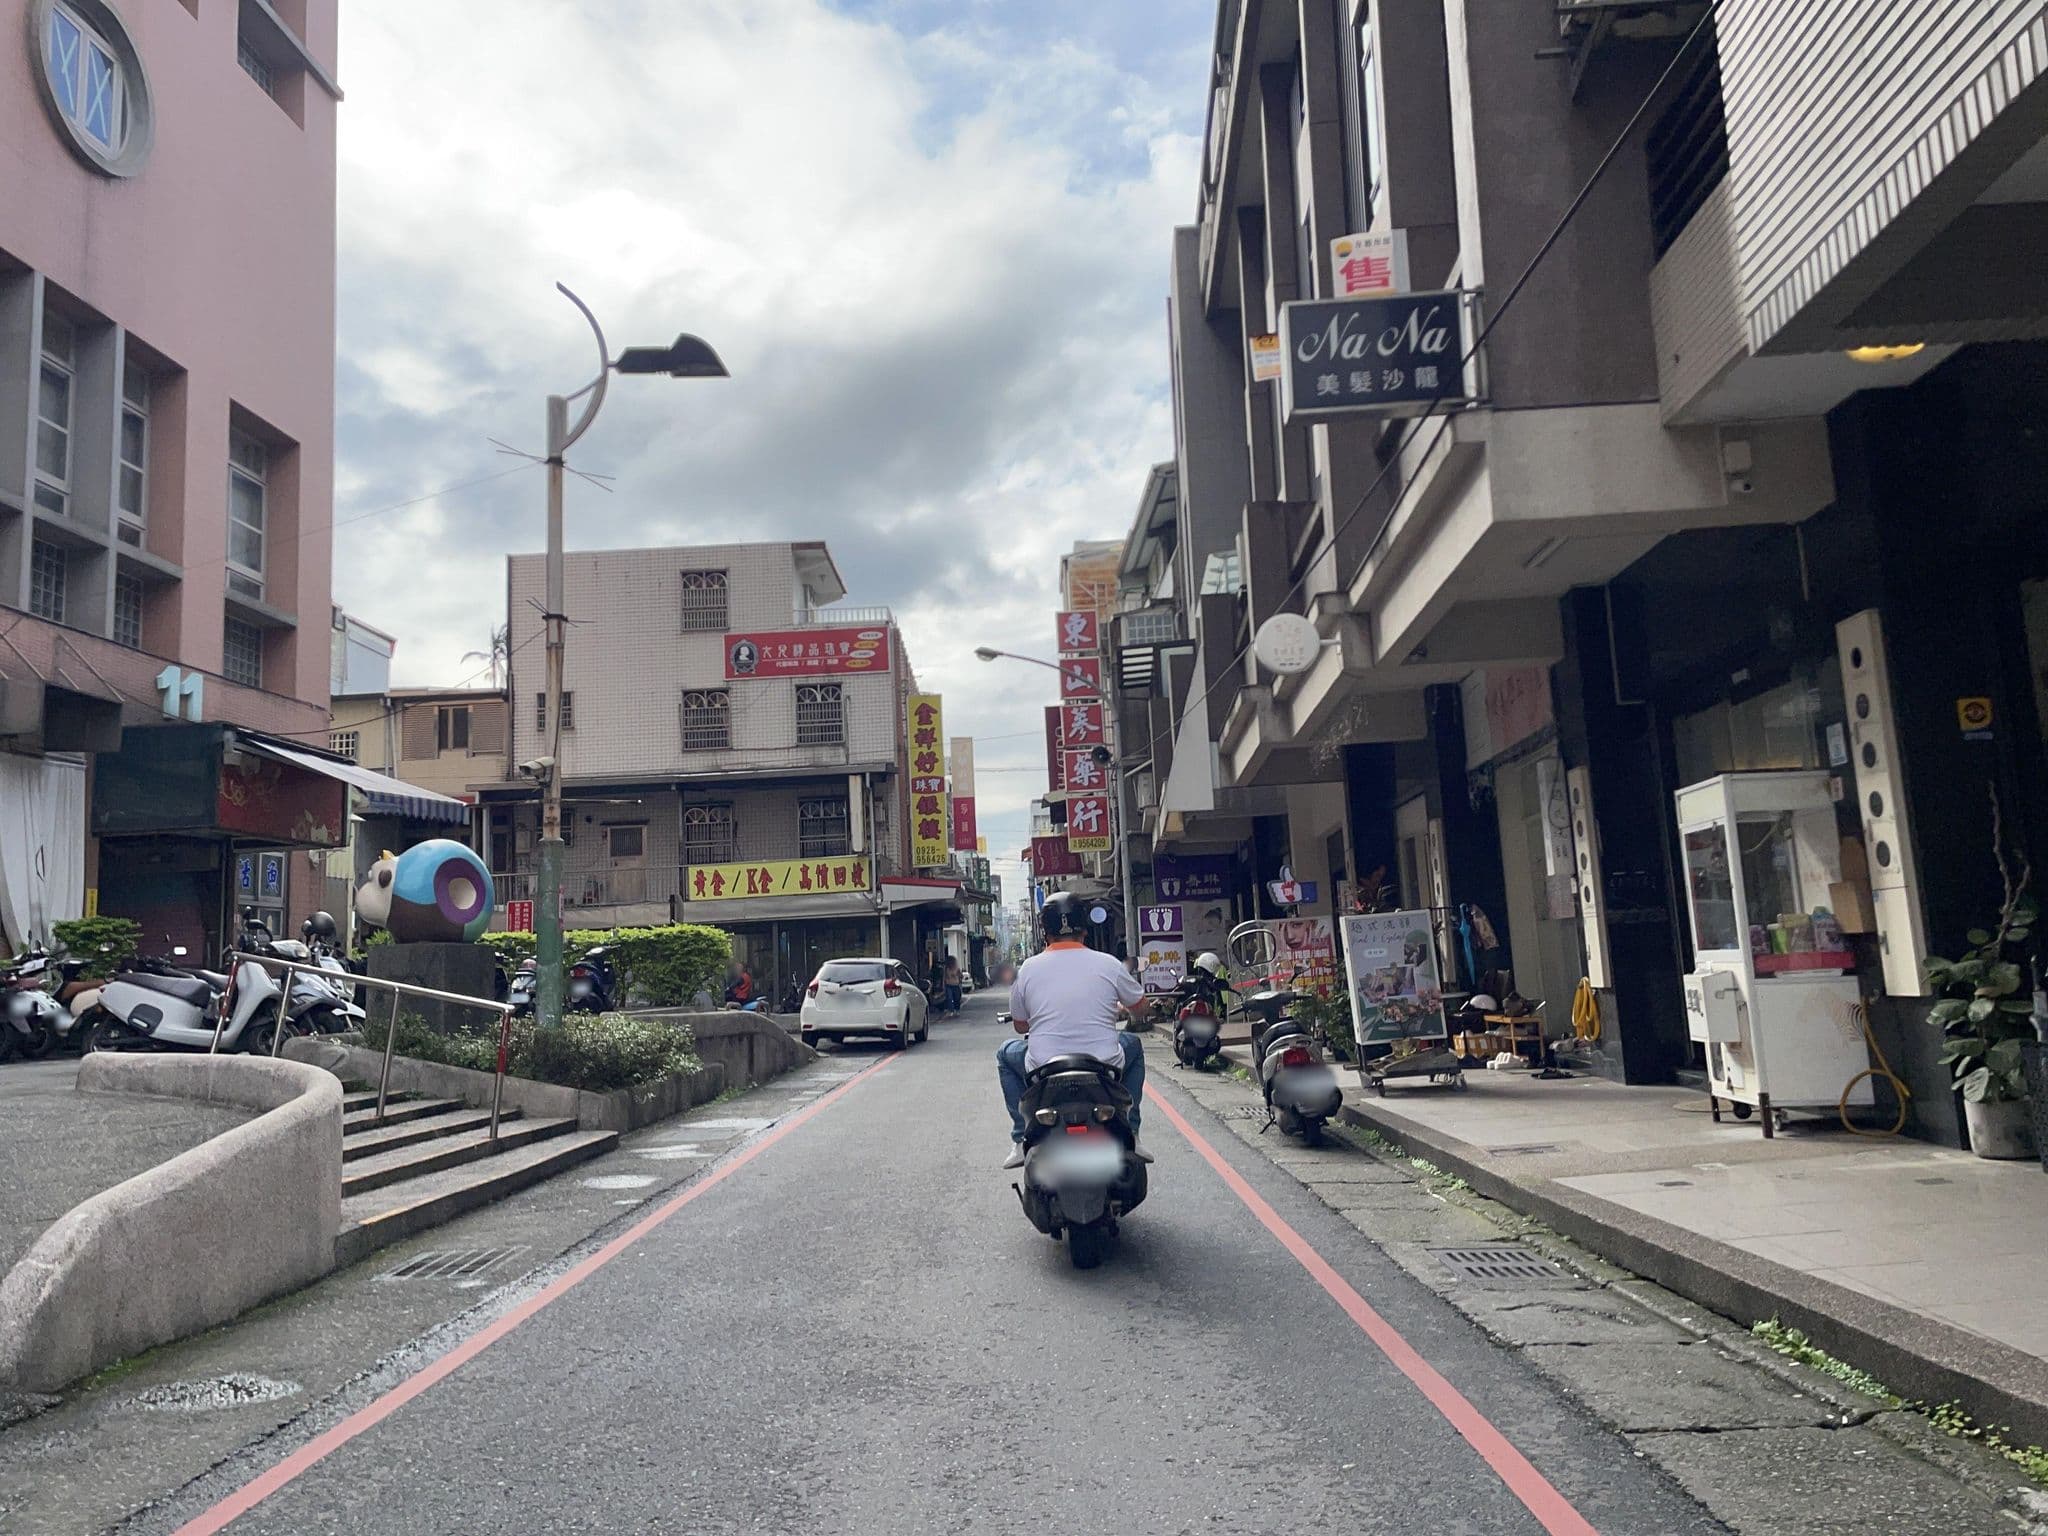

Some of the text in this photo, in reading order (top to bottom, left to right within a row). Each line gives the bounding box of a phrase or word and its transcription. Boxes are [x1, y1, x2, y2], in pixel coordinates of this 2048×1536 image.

[1340, 256, 1391, 293] 售
[1297, 305, 1453, 363] Na Na
[1317, 366, 1438, 396] 美髮沙龍
[915, 778, 941, 792] 珠寶
